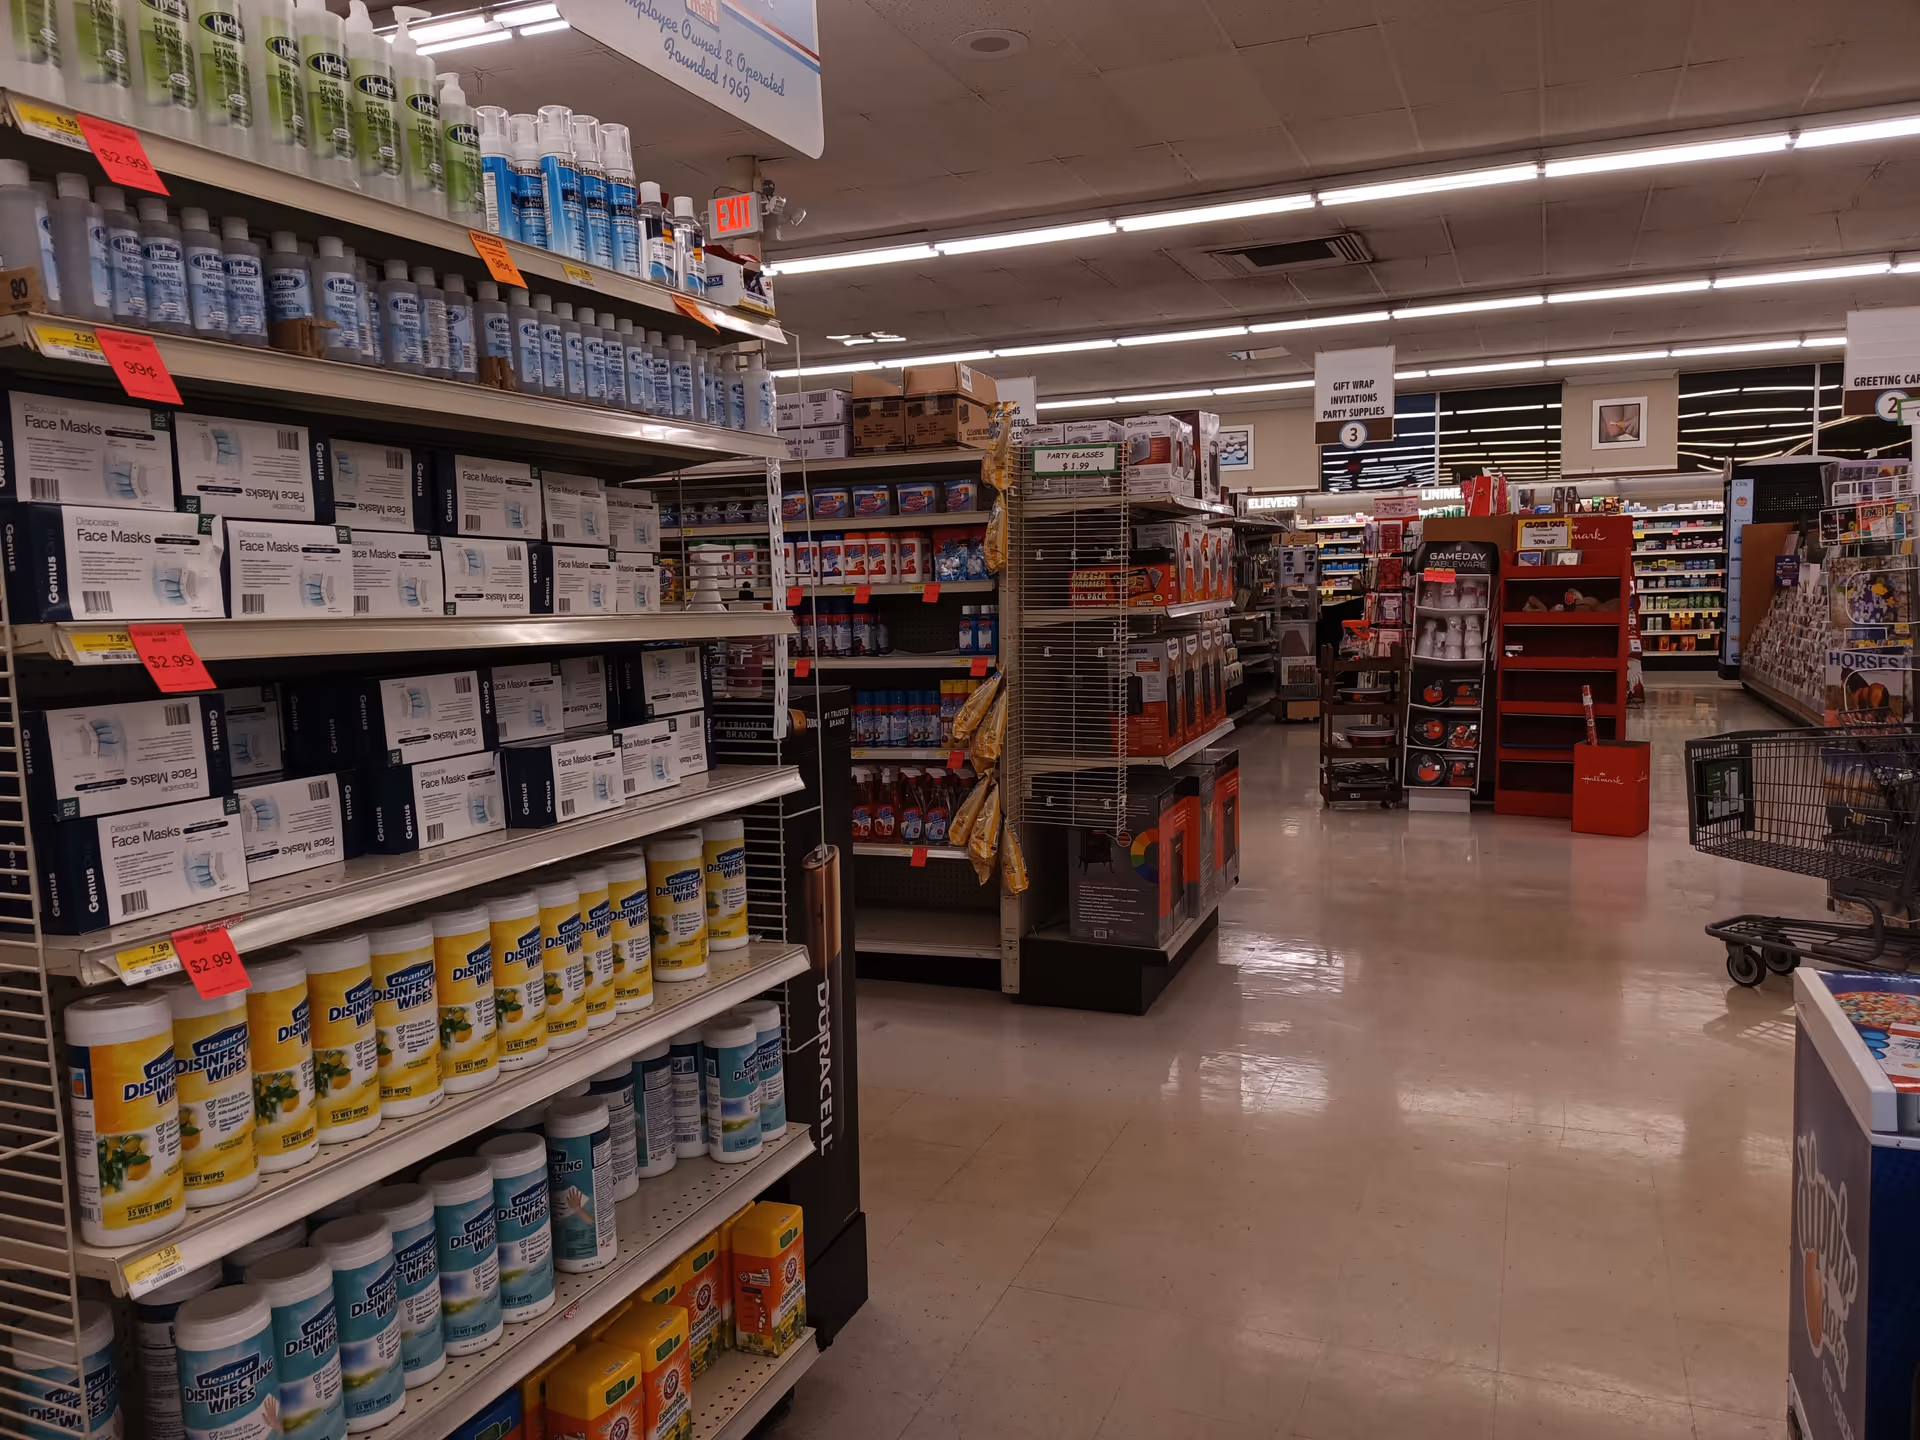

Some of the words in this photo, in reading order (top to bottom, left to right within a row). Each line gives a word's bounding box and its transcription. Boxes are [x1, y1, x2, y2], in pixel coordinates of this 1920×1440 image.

[623, 0, 678, 33] mployee
[682, 19, 721, 60] Owned
[726, 50, 733, 67] &
[737, 53, 784, 96] Operated
[664, 38, 719, 84] Founded
[722, 74, 750, 103] 1969
[320, 86, 344, 98] HAND
[367, 107, 390, 118] HAND
[57, 117, 78, 129] 6.99
[99, 148, 148, 170] $2.99
[716, 195, 750, 232] EXIT
[152, 264, 179, 272] INSTANT
[157, 271, 177, 279] HAND
[10, 278, 28, 300] 80
[74, 333, 95, 344] 2.29
[124, 360, 158, 379] 99¢
[1333, 380, 1350, 392] GIFT
[1352, 379, 1375, 390] WRAP
[1854, 375, 1901, 388] GREETING
[1330, 393, 1377, 405] INVITATIONS
[1887, 396, 1898, 414] 2
[154, 413, 165, 422] 25
[1322, 408, 1347, 420] PARTY
[1349, 406, 1385, 418] SUPPLIES
[25, 415, 57, 430] Face
[61, 419, 102, 435] Masks
[1350, 427, 1358, 442] 3
[316, 442, 325, 481] Genius
[462, 471, 479, 482] Face
[481, 473, 504, 484] Masks
[245, 488, 279, 500] Masks
[281, 490, 304, 502] Face
[548, 484, 561, 494] Face
[562, 486, 579, 495] Masks
[358, 503, 385, 513] Masks
[617, 500, 633, 508] Masks
[1248, 496, 1298, 508] ELIEVERS
[387, 504, 405, 515] Face
[77, 529, 108, 542] Face
[111, 530, 151, 544] Masks
[5, 523, 16, 572] Genius
[239, 540, 264, 552] Face
[267, 541, 300, 553] Masks
[369, 549, 397, 559] Masks
[1430, 552, 1487, 560] GAMEDAY
[558, 560, 572, 569] Face
[573, 561, 589, 569] Masks
[1429, 561, 1486, 569] TABLEWARE
[48, 556, 58, 604] Genius
[485, 593, 507, 601] Masks
[509, 593, 524, 601] Face
[108, 634, 128, 642] 7.99
[148, 655, 194, 669] $2.99
[1829, 652, 1899, 669] HORSES
[507, 679, 527, 690] Masks
[482, 680, 491, 714] Genius
[359, 695, 368, 730] Genius
[830, 708, 849, 718] TRUSTED
[830, 718, 845, 727] BRAND
[208, 710, 220, 751] Genius
[726, 731, 757, 739] BRAND
[635, 738, 651, 747] Masks
[558, 757, 572, 767] Face
[573, 754, 592, 764] Masks
[130, 770, 168, 786] Masks
[170, 767, 198, 781] Face
[421, 776, 440, 789] Face
[441, 774, 466, 785] Masks
[226, 798, 236, 806] 25
[344, 785, 353, 821] Genius
[522, 782, 530, 816] Genius
[377, 807, 385, 842] Genius
[405, 804, 413, 840] Genius
[112, 832, 140, 848] Face
[143, 826, 181, 842] Masks
[314, 836, 335, 848] Face
[282, 842, 312, 855] Masks
[722, 866, 745, 879] WIPES
[49, 872, 61, 918] Genius
[87, 867, 100, 914] Genius
[672, 890, 699, 903] WIPES
[150, 942, 170, 954] 7.99
[190, 952, 232, 973] $2.99
[392, 965, 432, 986] CleanCut
[397, 989, 432, 1010] WIPES
[199, 1028, 248, 1054] CleanCut
[206, 1055, 248, 1083] WIPES
[817, 979, 833, 1157] DURACELL
[393, 1086, 412, 1096] WIPES
[340, 1108, 351, 1119] WET
[351, 1104, 369, 1117] WIPES
[340, 1108, 353, 1119] WET
[354, 1104, 369, 1116] WIPES
[190, 1172, 202, 1183] WET
[203, 1170, 224, 1181] WIPES
[128, 1209, 136, 1218] 35
[137, 1203, 153, 1217] WET
[153, 1197, 172, 1213] WIPES
[520, 1206, 548, 1227] WIPES
[156, 1245, 176, 1262] 1.99
[406, 1262, 437, 1284] WIPES
[202, 1358, 254, 1387] CleanCut
[185, 1357, 274, 1403] DISINFECTING
[208, 1387, 256, 1415] WIPES
